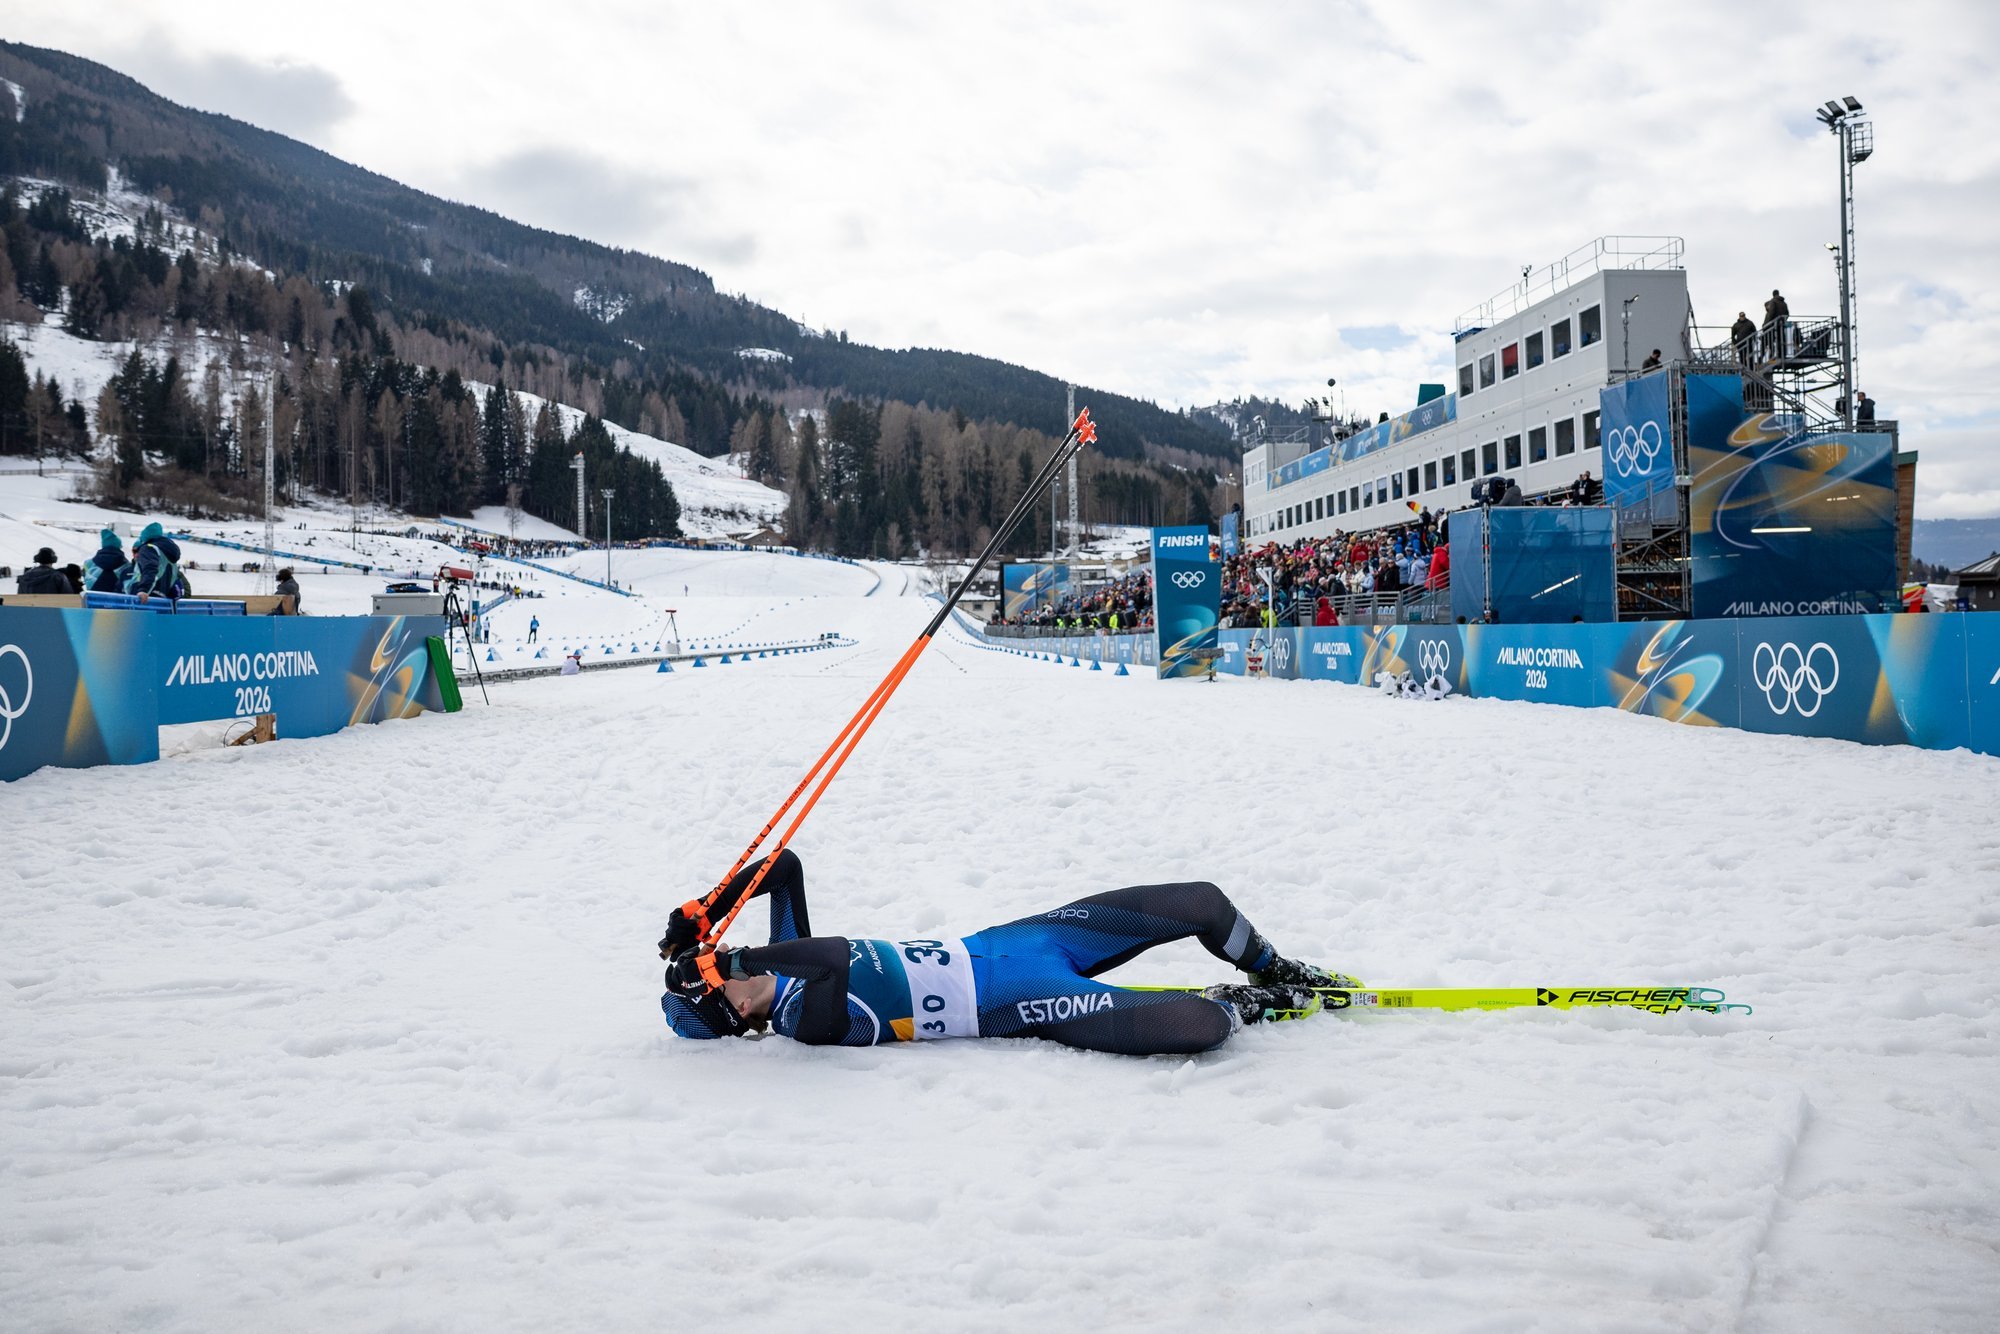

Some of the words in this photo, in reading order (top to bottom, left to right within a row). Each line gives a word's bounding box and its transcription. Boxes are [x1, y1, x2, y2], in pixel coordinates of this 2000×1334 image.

[1159, 534, 1204, 548] FINISH
[1722, 601, 1794, 615] MILANO
[1797, 601, 1869, 614] CORTINA
[165, 653, 251, 686] MILANO
[253, 650, 319, 680] CORTINA
[1496, 647, 1535, 666] MILANO
[1535, 648, 1584, 669] CORTINA
[1525, 669, 1547, 689] 2026
[235, 686, 271, 715] 2026
[1047, 908, 1089, 919] odlo
[898, 940, 950, 966] 30
[1017, 992, 1114, 1023] ESTONIA
[1568, 990, 1690, 1003] FISCHER
[922, 994, 946, 1033] 30
